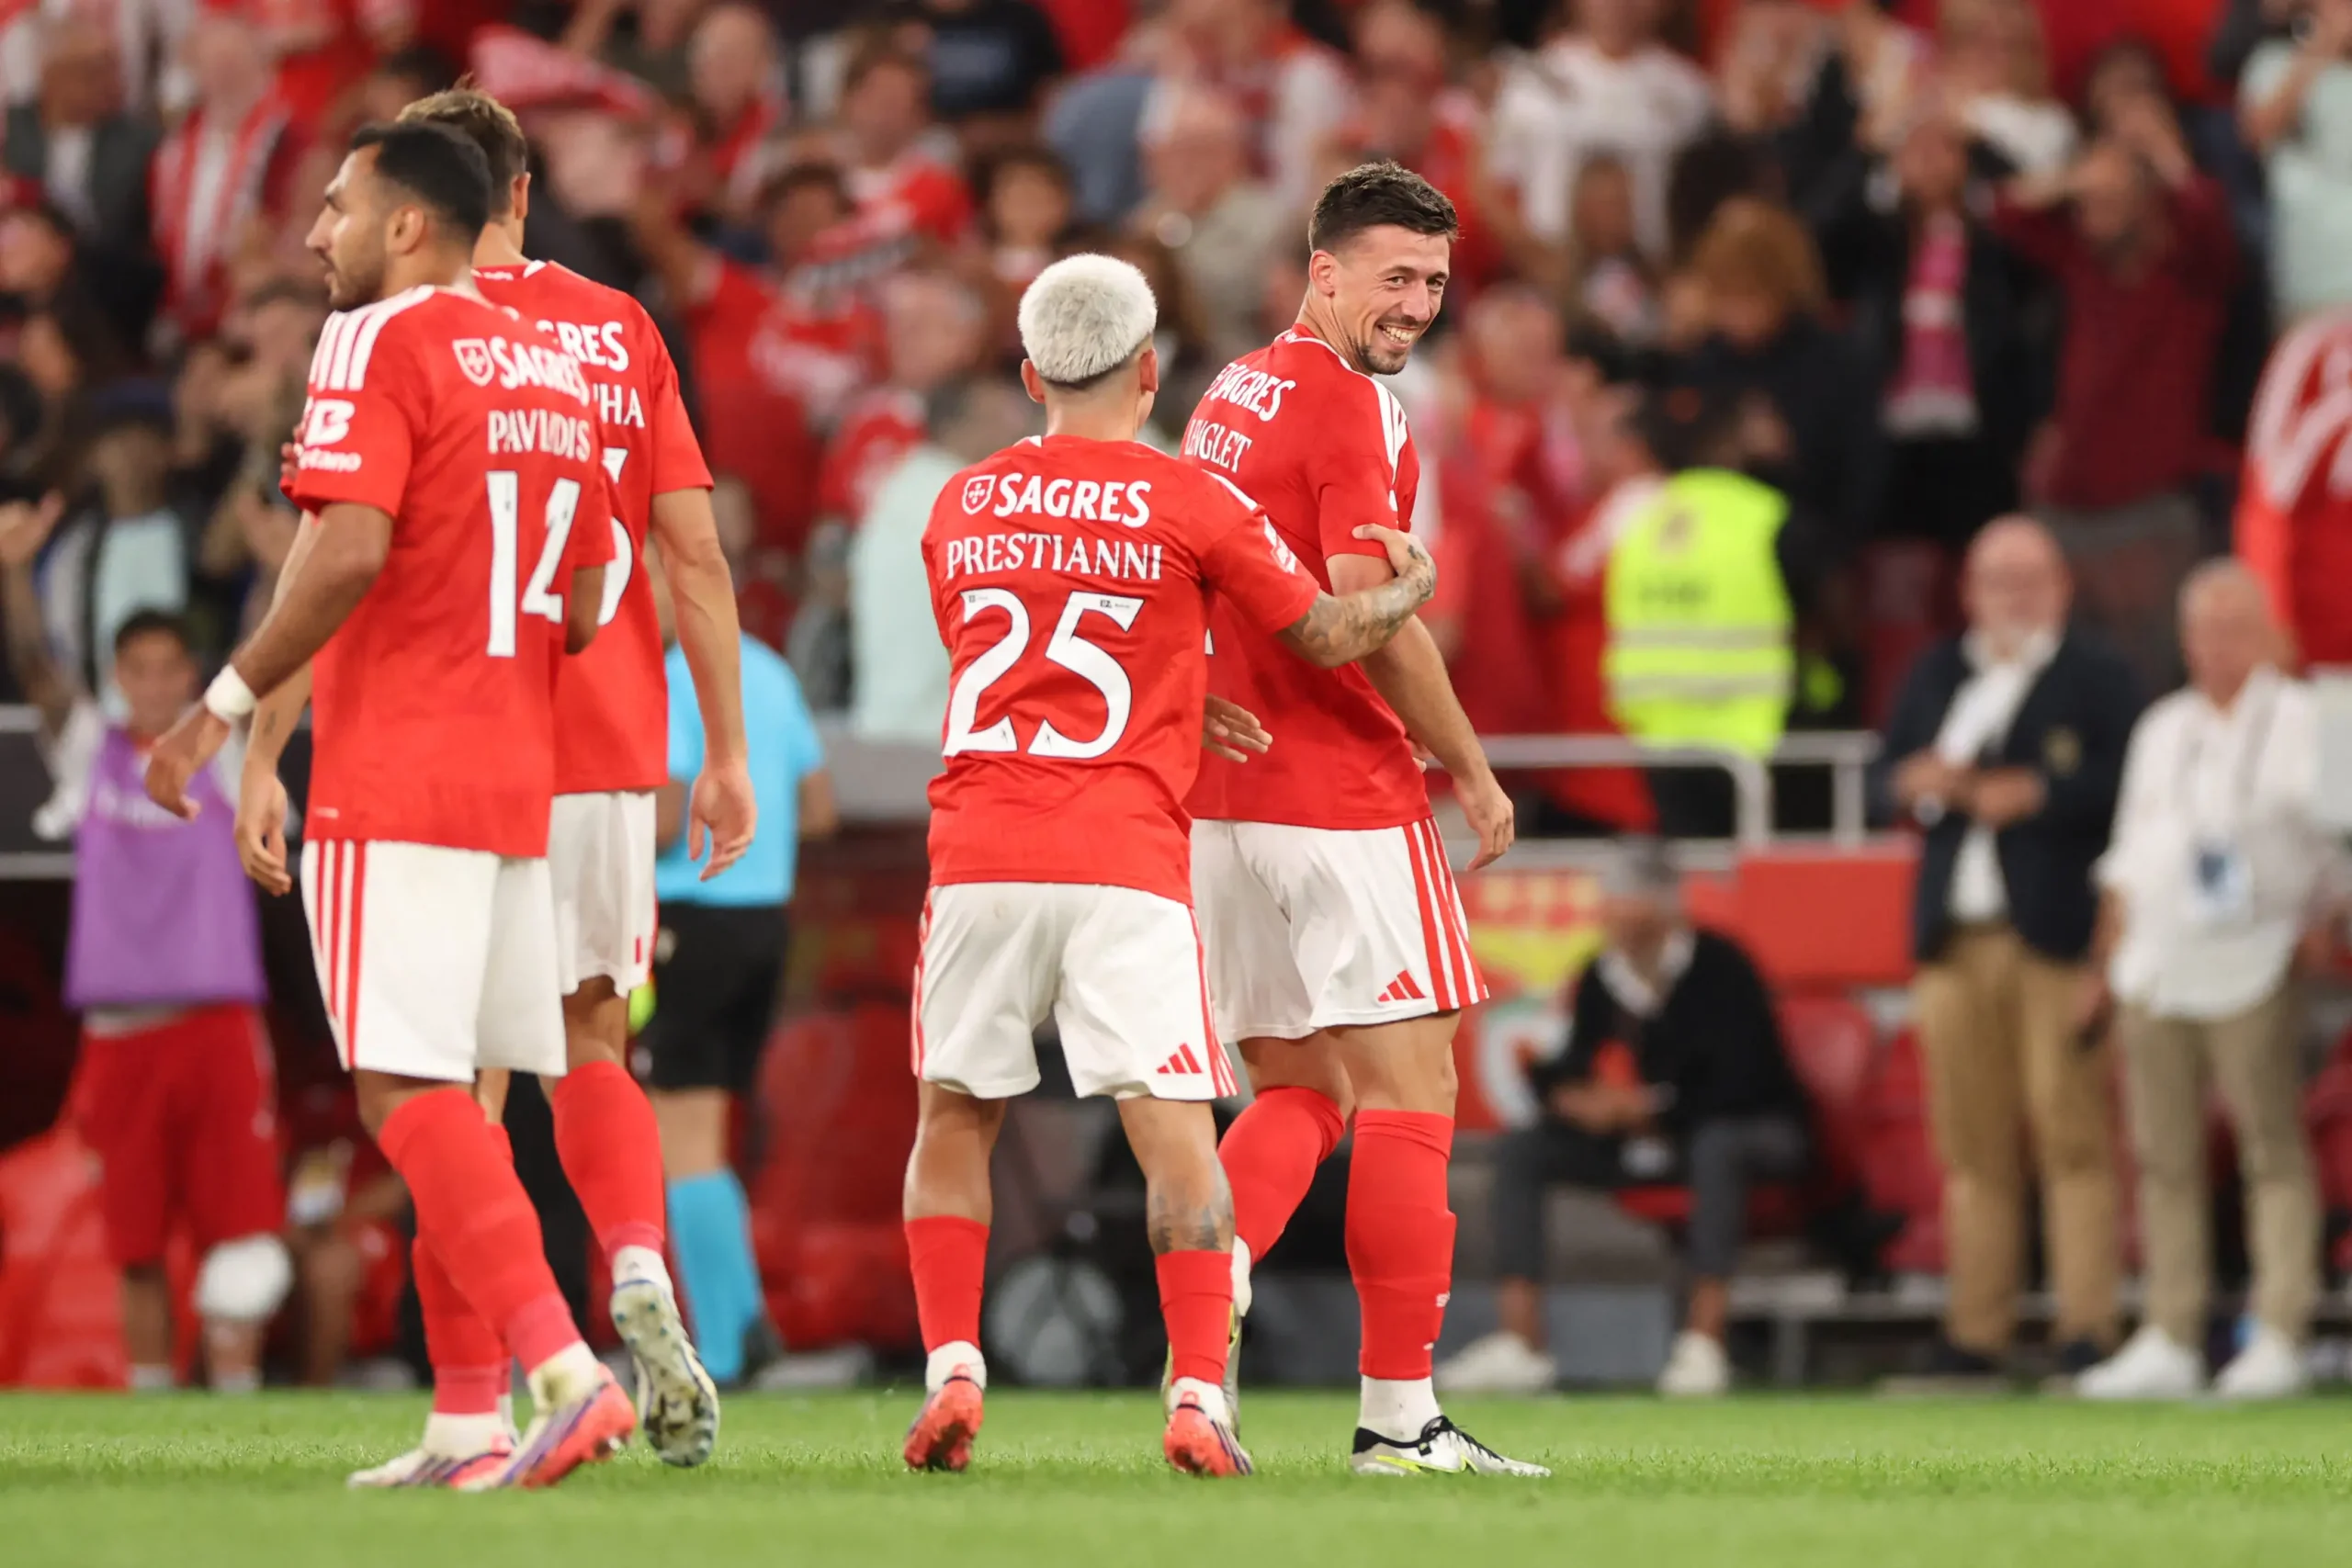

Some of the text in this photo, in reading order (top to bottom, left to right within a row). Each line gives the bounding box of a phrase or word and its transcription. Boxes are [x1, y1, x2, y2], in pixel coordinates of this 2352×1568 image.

[992, 472, 1152, 529] SAGRES
[946, 532, 1163, 581] PRESTIANNI
[941, 586, 1146, 761] 25
